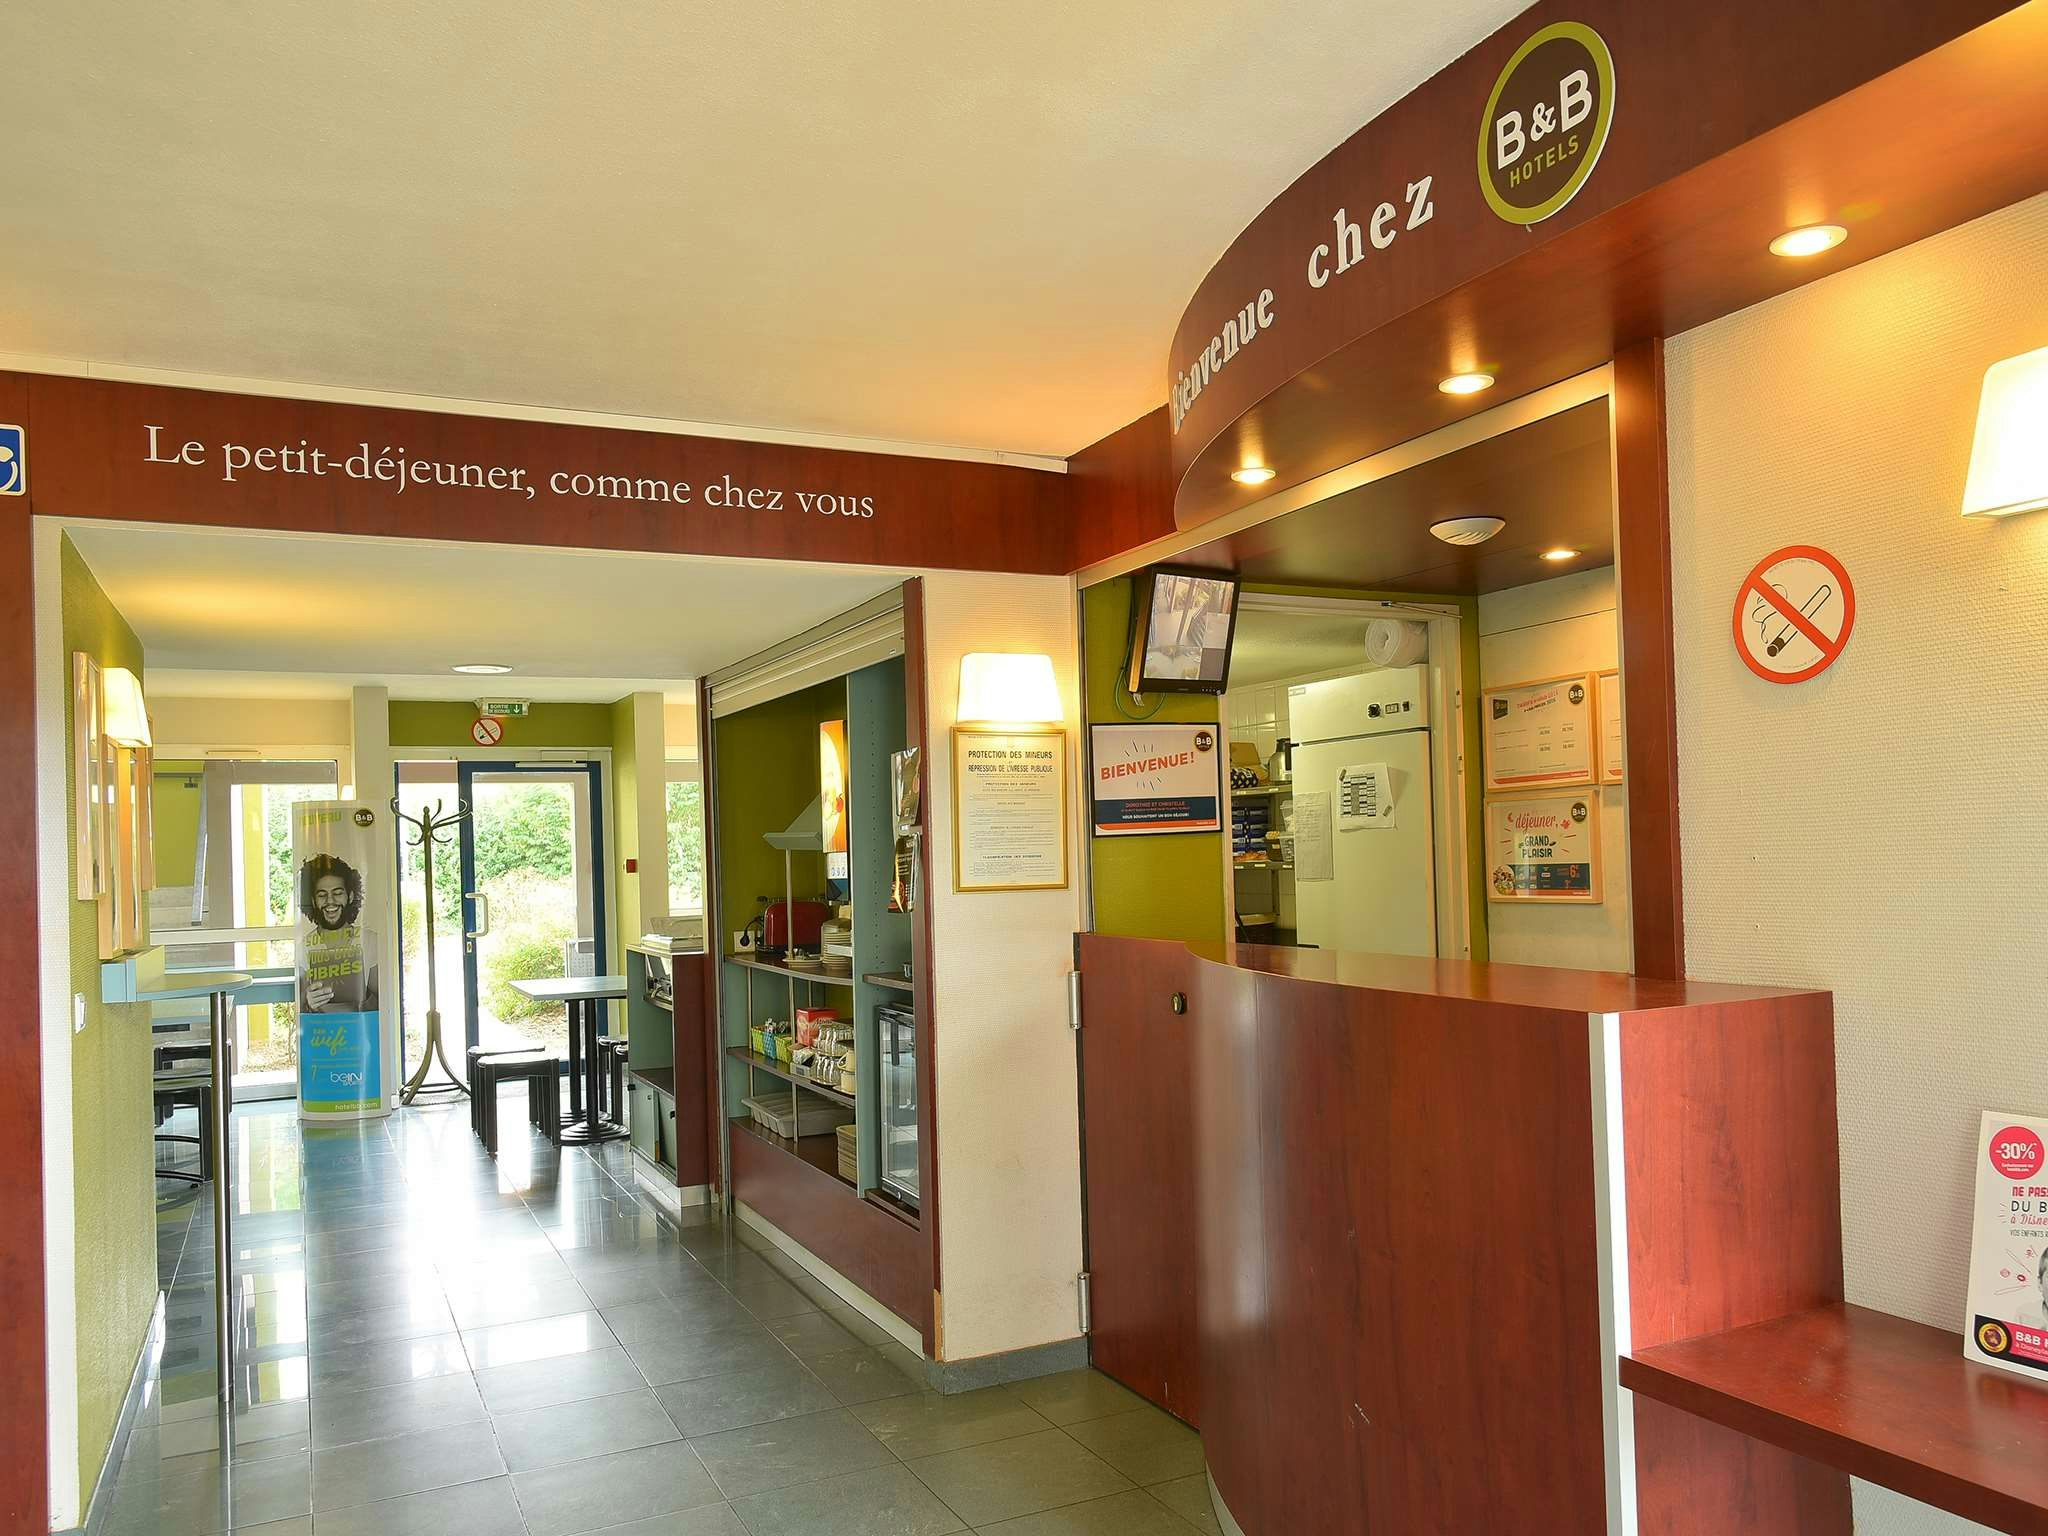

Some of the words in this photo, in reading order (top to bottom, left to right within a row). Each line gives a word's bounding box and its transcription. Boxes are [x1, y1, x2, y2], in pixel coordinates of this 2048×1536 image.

[1496, 69, 1593, 170] B&B
[1509, 135, 1580, 189] HOTELS
[1307, 175, 1434, 289] chez
[144, 425, 206, 465] Le
[222, 439, 536, 499] petit-déjeuner,
[549, 471, 692, 504] comme
[703, 475, 784, 511] chez
[795, 491, 874, 518] vous
[1569, 689, 1583, 699] B&B
[1196, 737, 1212, 746] B&B
[968, 751, 1007, 759] PROTECTION
[1009, 751, 1022, 759] DES
[1025, 751, 1053, 759] MINEURS
[998, 765, 1005, 773] DE
[1030, 765, 1053, 773] PUBLIQUE
[355, 813, 374, 821] B&B
[1572, 807, 1586, 816] B&B
[1524, 835, 1549, 847] GRAND
[1522, 848, 1553, 858] PLAISIR
[305, 959, 362, 982] FIBRÉS
[2012, 1186, 2025, 1197] NE
[2011, 1200, 2031, 1212] DU
[2016, 1331, 2041, 1346] B&B
